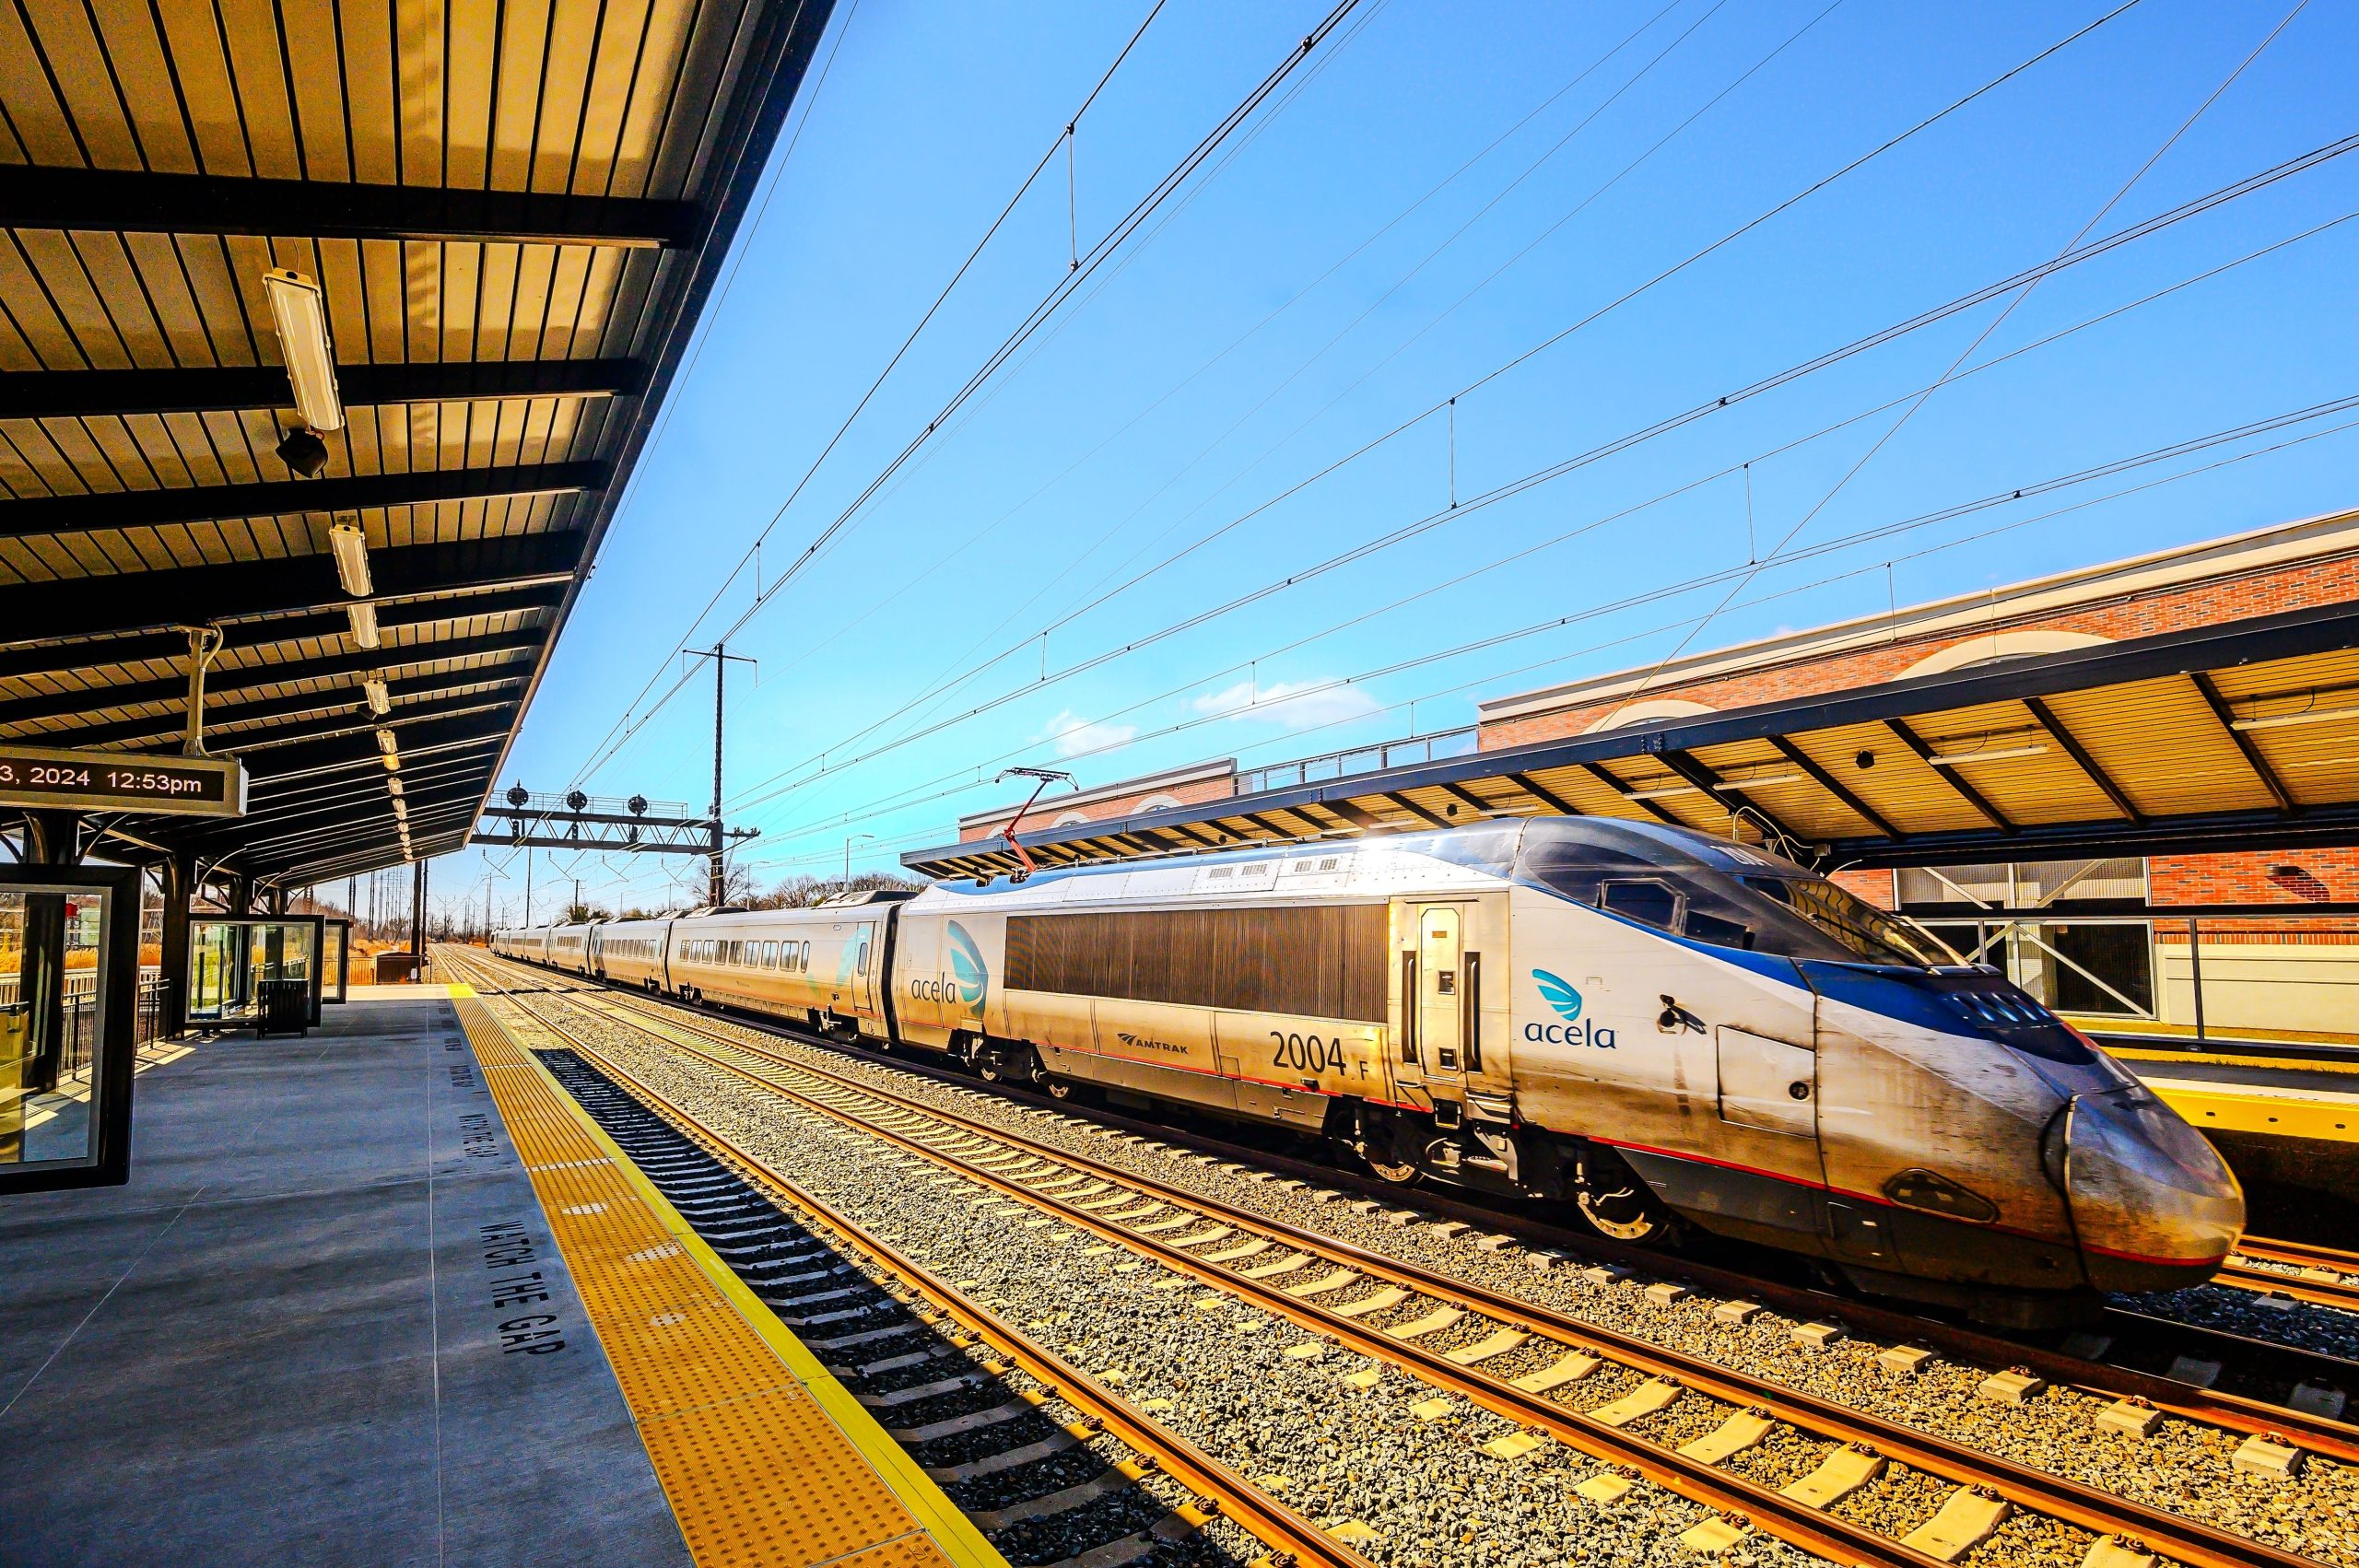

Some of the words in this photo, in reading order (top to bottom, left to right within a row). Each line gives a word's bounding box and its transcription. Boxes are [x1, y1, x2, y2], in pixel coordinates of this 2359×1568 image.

[0, 766, 20, 784] 3,
[29, 766, 90, 786] 2024
[107, 771, 202, 794] 12:53pm
[911, 971, 957, 1004] acela
[1135, 1039, 1189, 1054] AMTRAK
[1524, 1018, 1616, 1049] acela
[1270, 1031, 1346, 1076] 2004
[1358, 1059, 1368, 1081] F
[479, 1220, 536, 1269] WATCH
[489, 1271, 549, 1308] THE
[498, 1315, 566, 1355] GAP
